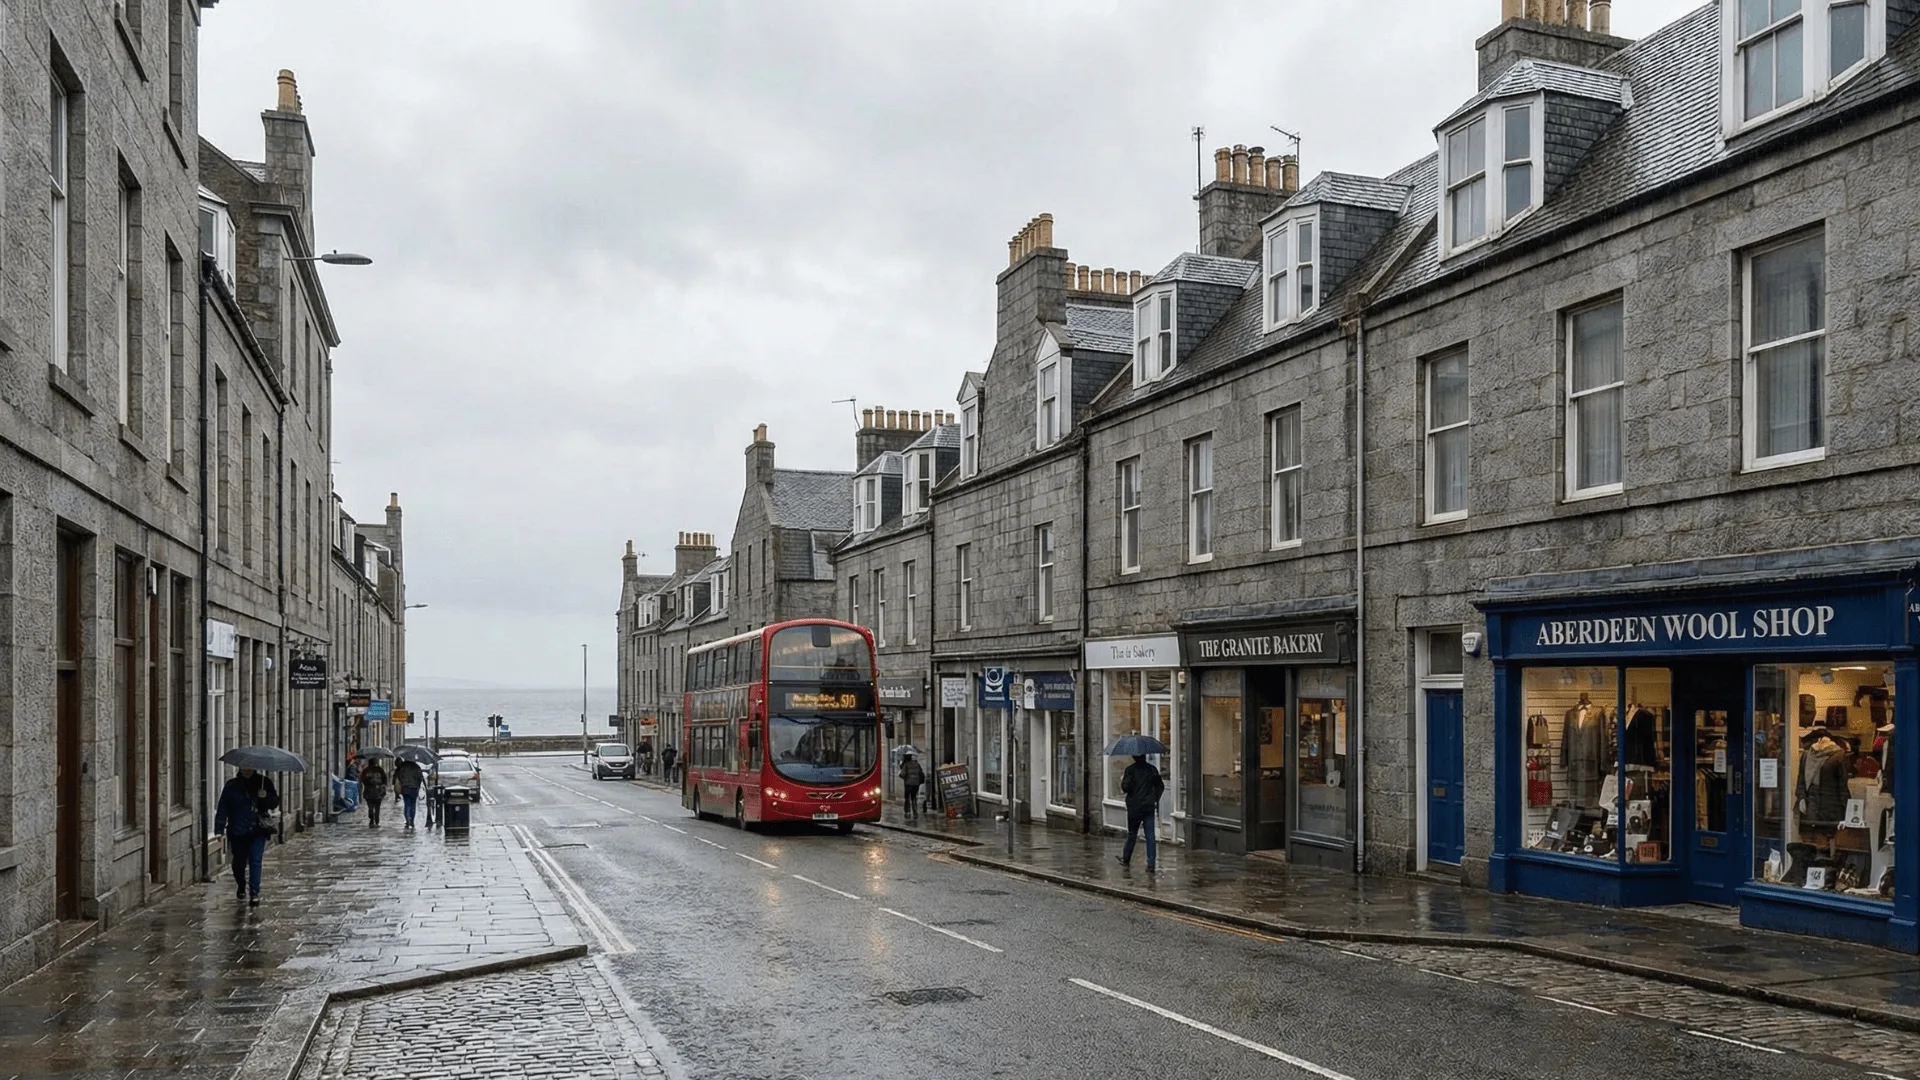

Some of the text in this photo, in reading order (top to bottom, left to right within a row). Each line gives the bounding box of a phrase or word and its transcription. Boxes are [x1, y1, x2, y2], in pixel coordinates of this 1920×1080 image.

[1536, 605, 1835, 645] ABERDEEN WOOL SHOP
[1199, 633, 1324, 657] THE GRANITE BAKERY
